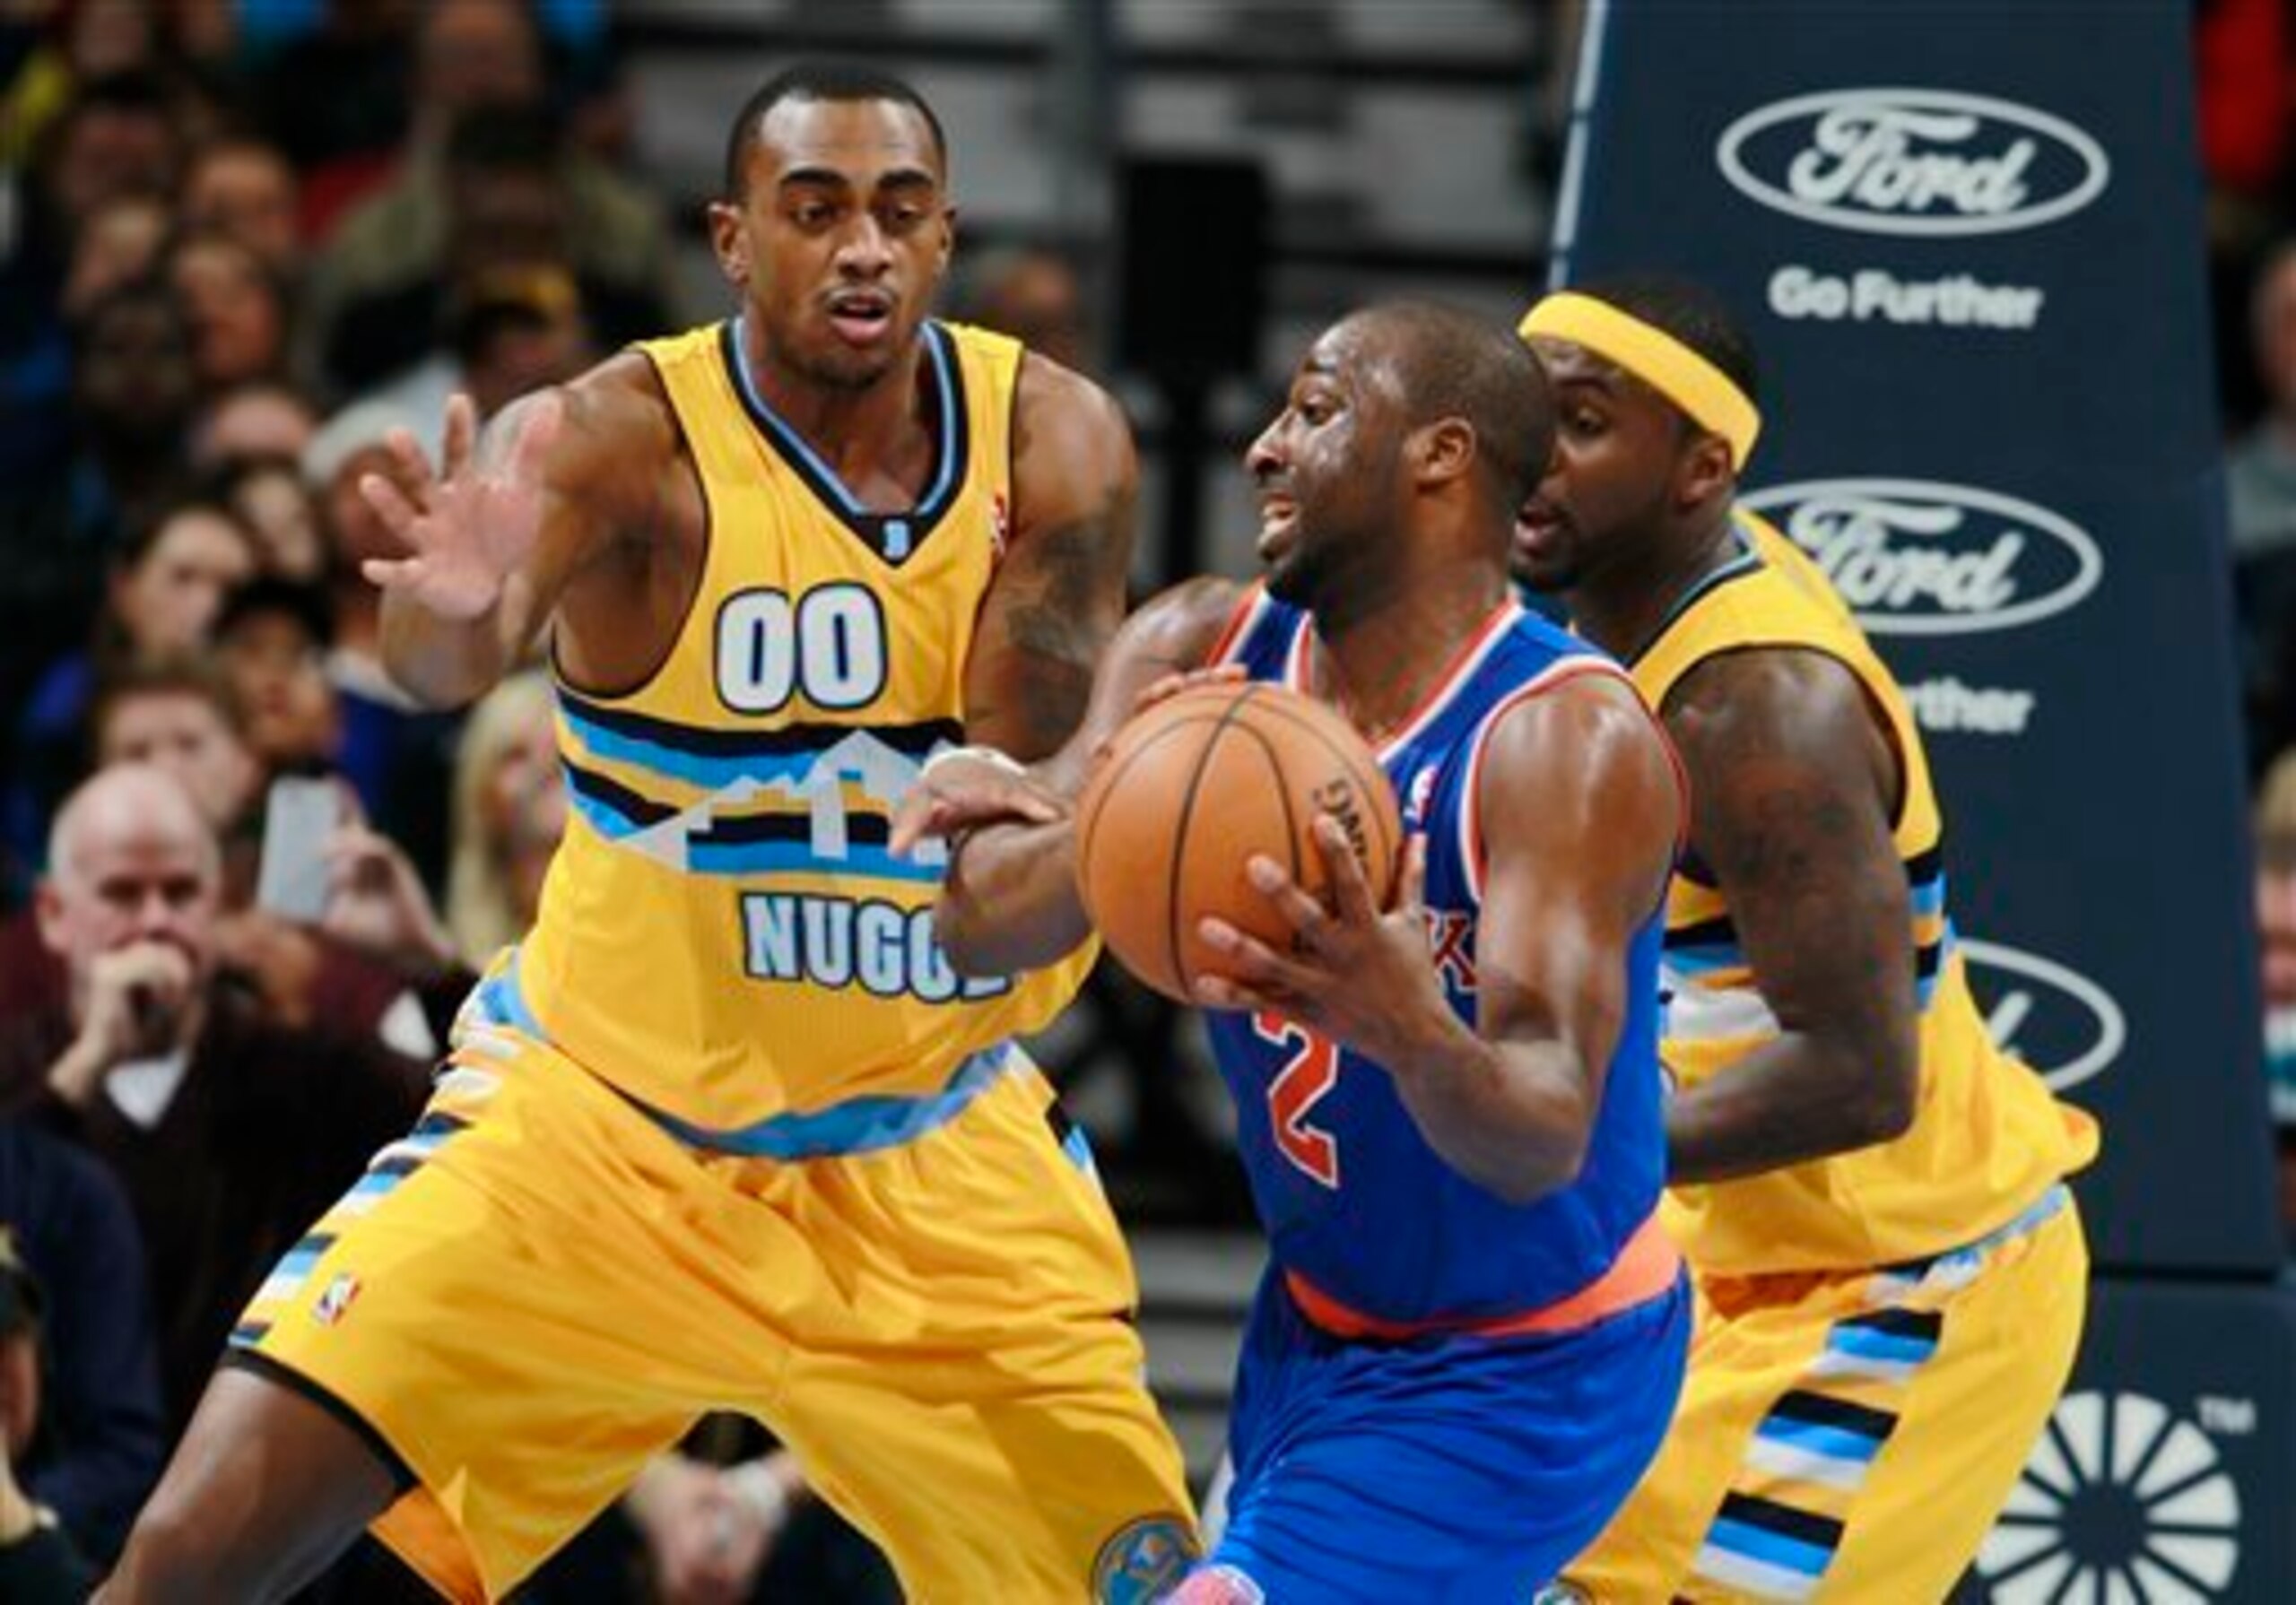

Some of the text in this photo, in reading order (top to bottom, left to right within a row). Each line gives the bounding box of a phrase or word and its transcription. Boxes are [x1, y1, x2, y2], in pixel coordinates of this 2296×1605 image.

[1788, 106, 2037, 215] Ford
[1768, 267, 2045, 328] Go Further
[1789, 498, 2023, 612] Ford
[713, 579, 889, 716] 00
[1252, 1009, 1339, 1189] 2
